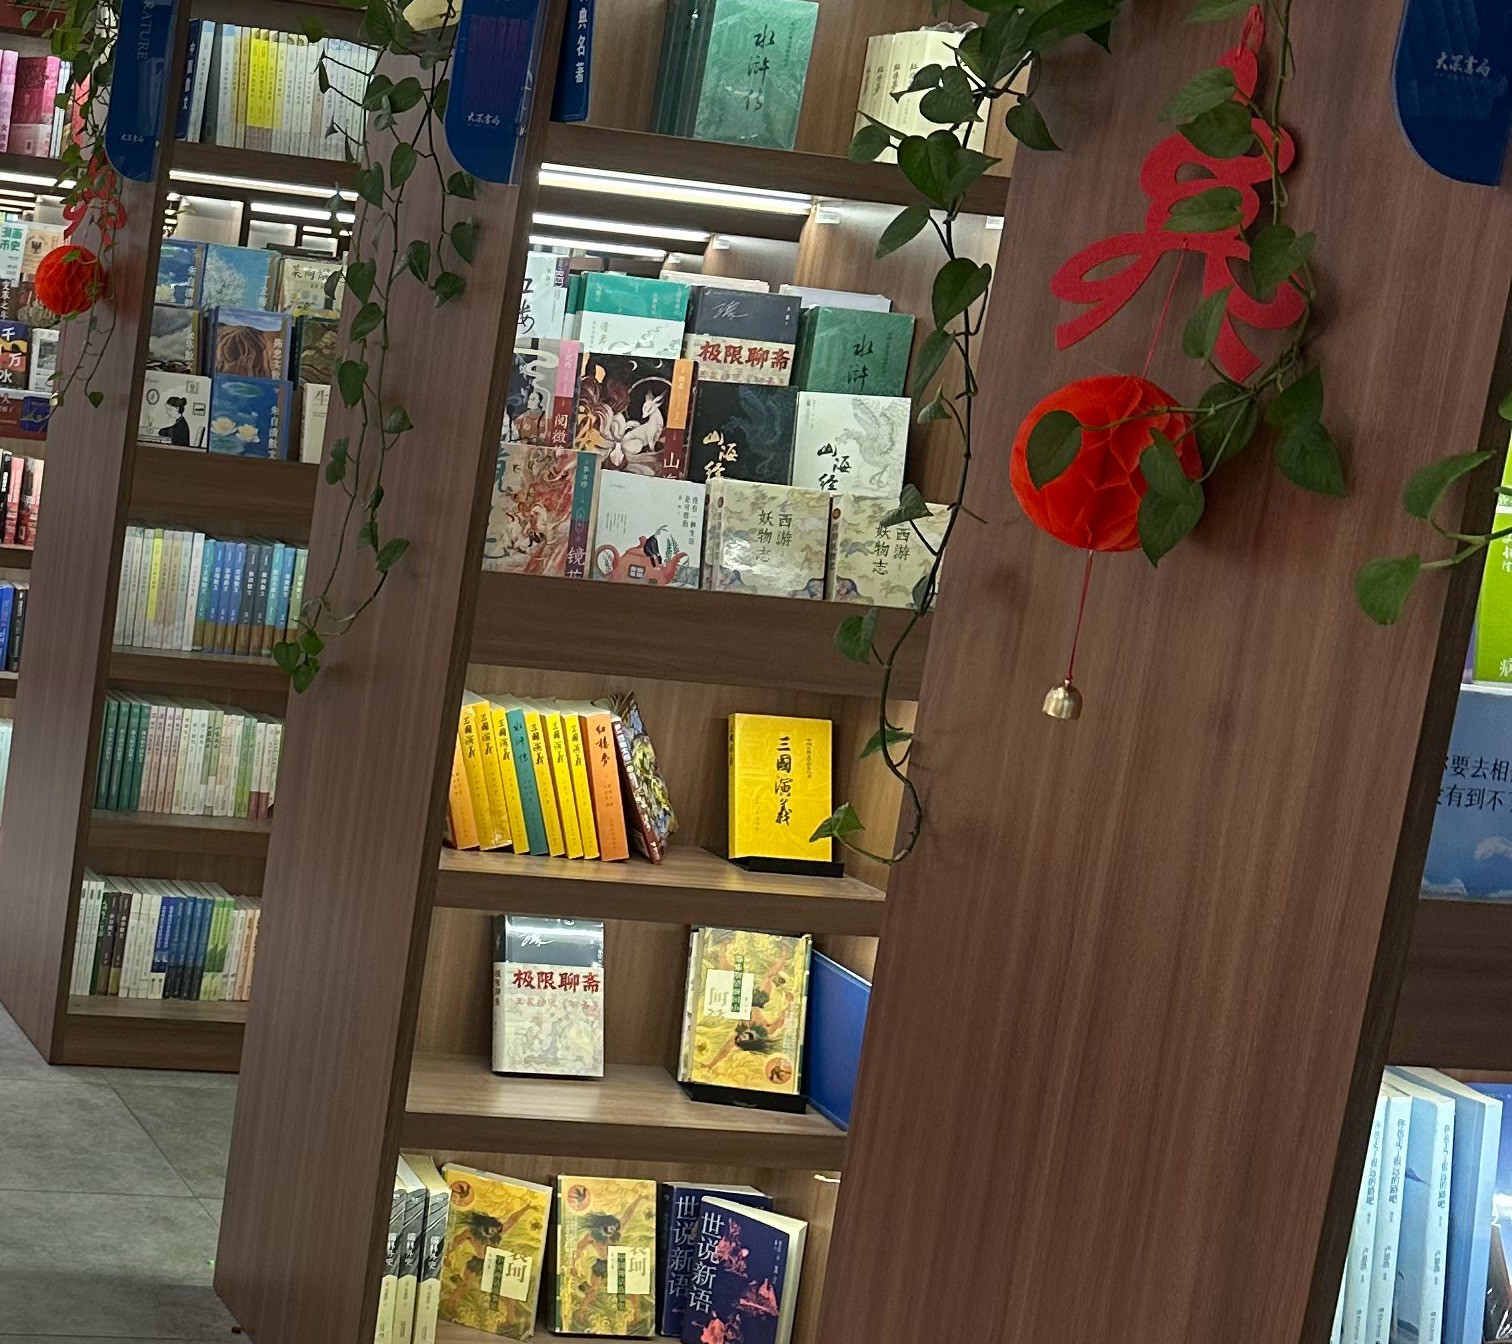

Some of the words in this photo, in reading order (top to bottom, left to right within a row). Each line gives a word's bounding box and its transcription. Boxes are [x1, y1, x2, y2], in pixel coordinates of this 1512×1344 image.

[698, 340, 791, 373] 极限聊斋
[816, 442, 853, 491] 山海经
[756, 509, 774, 564] 妖物志
[777, 513, 794, 546] 西游
[893, 527, 912, 560] 西游
[1439, 757, 1512, 782] 要去相
[1435, 788, 1512, 810] 有到不
[512, 969, 599, 992] 极限聊斋
[690, 1212, 725, 1312] 世说新语
